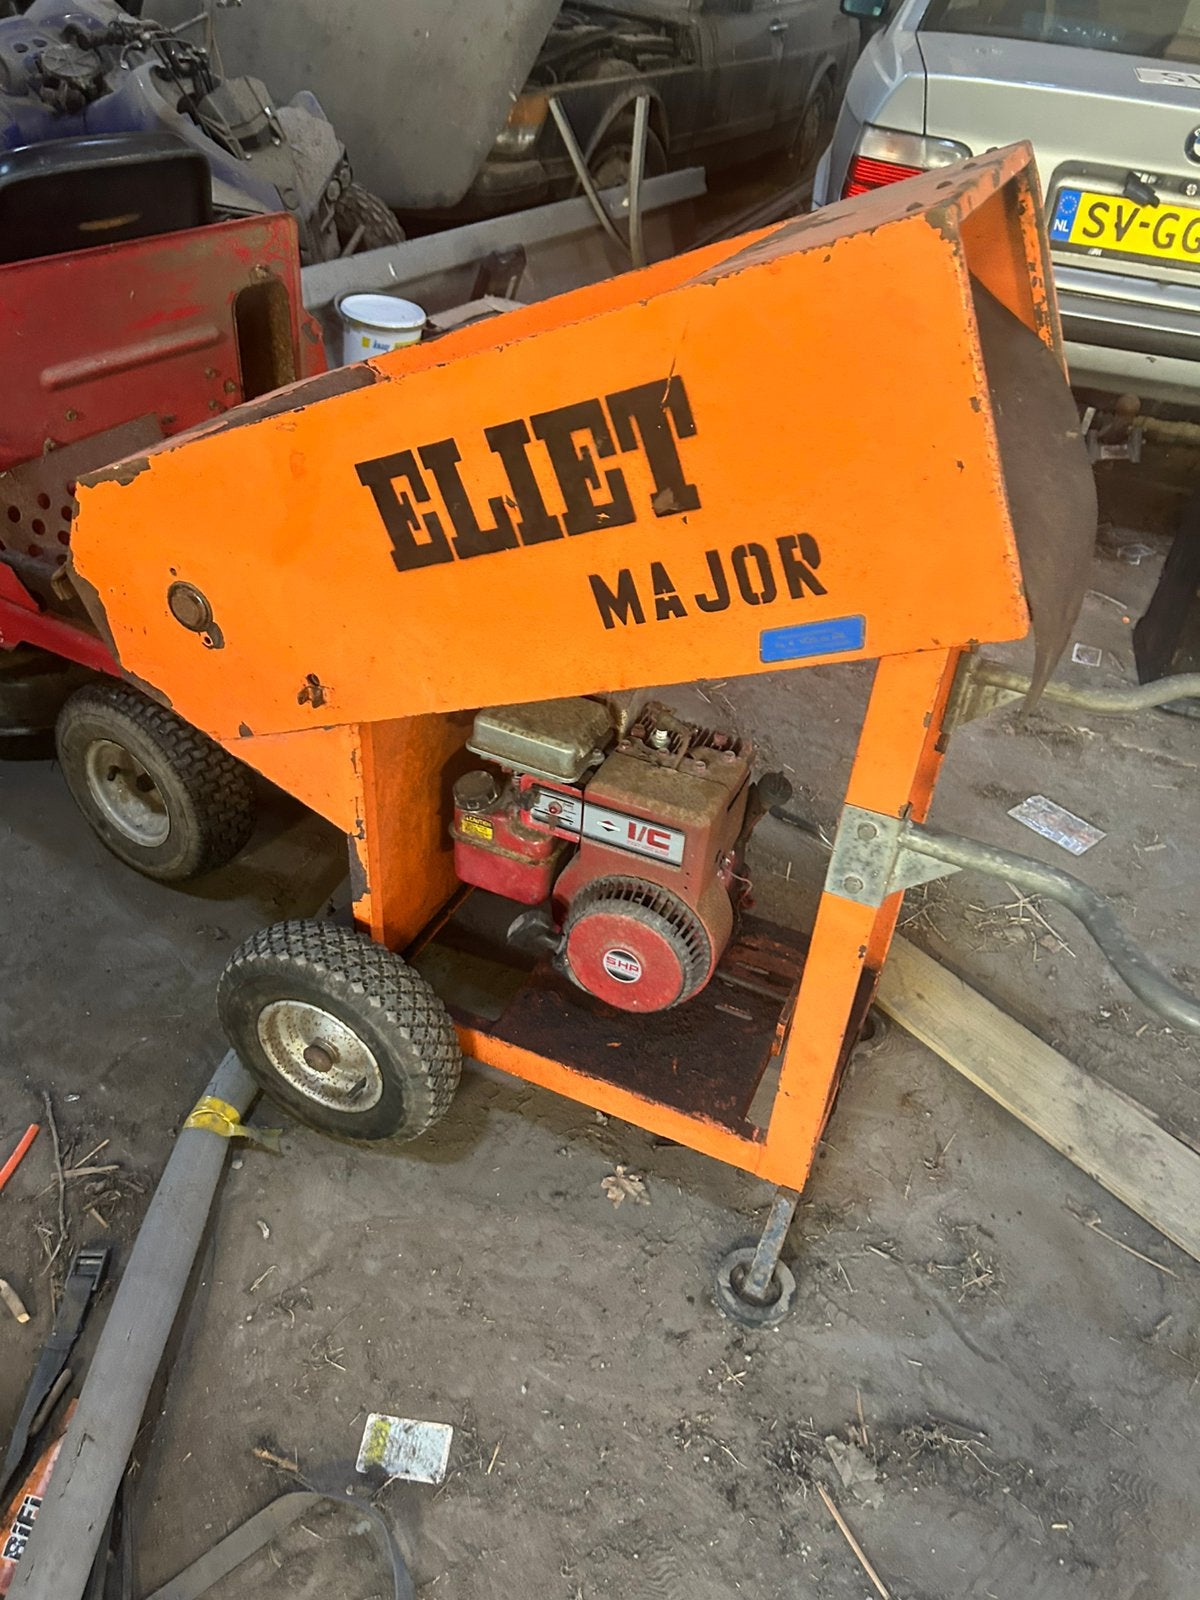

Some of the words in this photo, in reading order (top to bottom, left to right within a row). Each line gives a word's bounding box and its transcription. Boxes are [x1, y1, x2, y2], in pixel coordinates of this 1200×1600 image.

[1053, 219, 1069, 232] NL
[1082, 202, 1200, 253] SV-GG
[355, 375, 701, 572] ELIET
[588, 532, 828, 630] MAJOR
[627, 821, 671, 850] I/C
